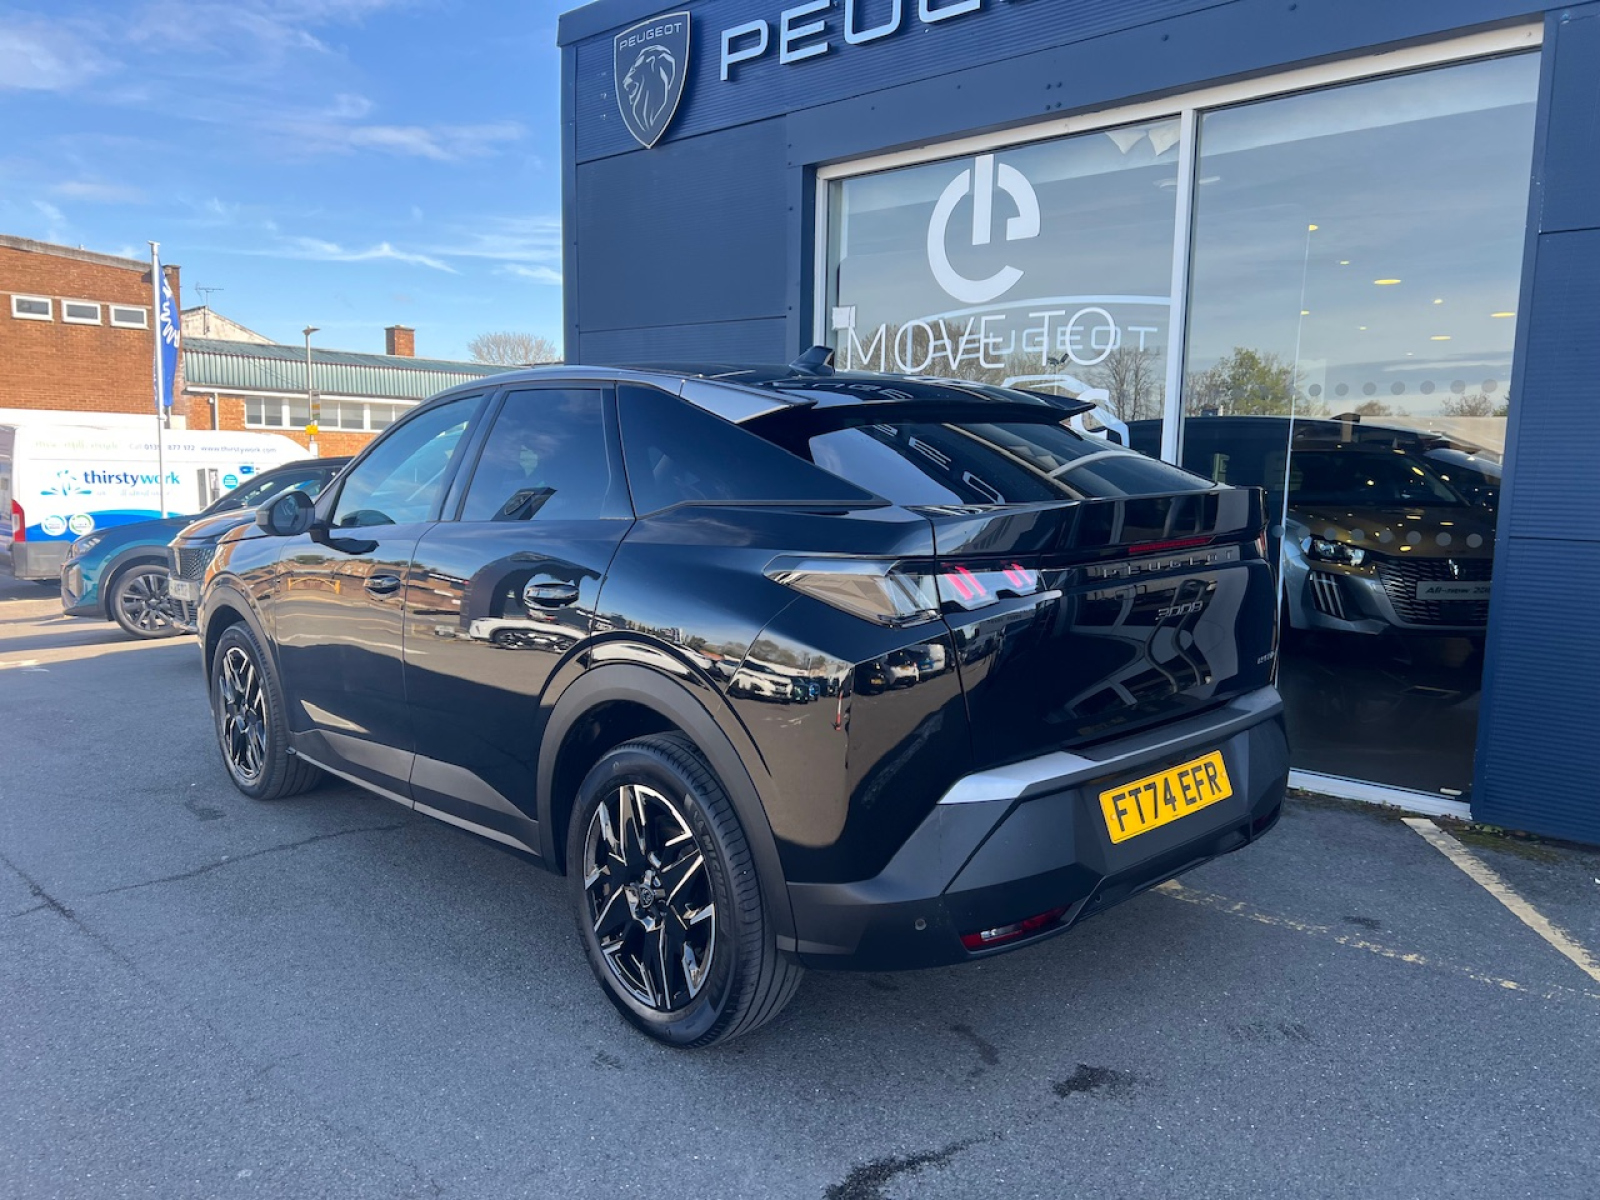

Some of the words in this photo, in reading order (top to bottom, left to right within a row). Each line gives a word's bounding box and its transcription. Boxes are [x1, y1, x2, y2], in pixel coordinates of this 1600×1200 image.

[619, 22, 682, 51] PEUGEOT
[846, 315, 1006, 373] MOVE
[1028, 307, 1117, 367] TO
[928, 325, 1158, 361] PEUGEOT
[83, 469, 180, 487] thirstywork
[1103, 550, 1233, 579] PEUGEOT
[1112, 777, 1177, 832] FT74
[1177, 760, 1222, 807] EFR
